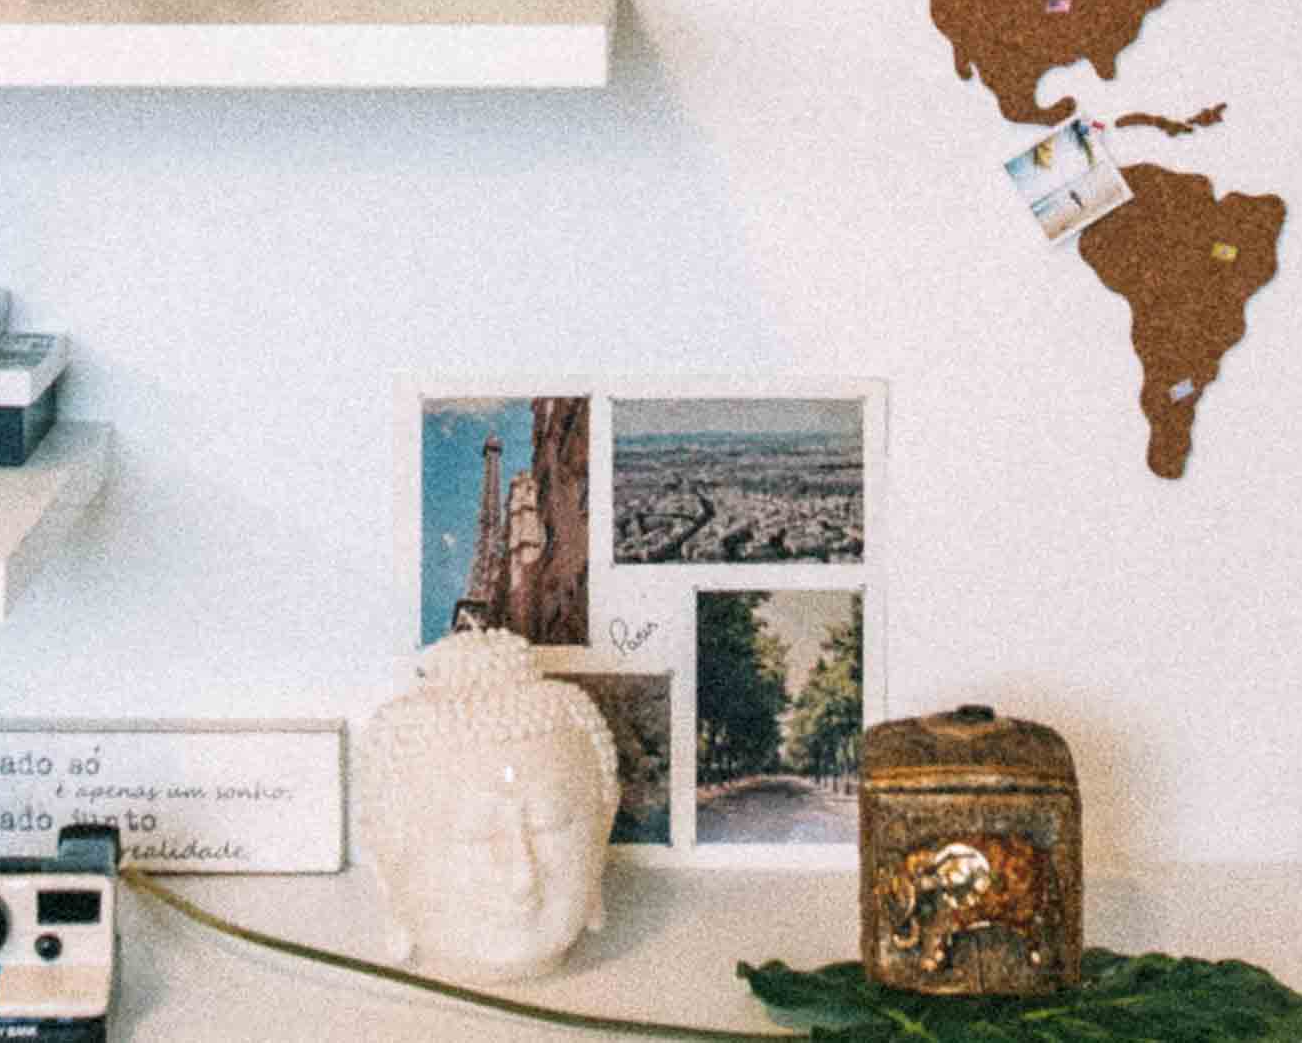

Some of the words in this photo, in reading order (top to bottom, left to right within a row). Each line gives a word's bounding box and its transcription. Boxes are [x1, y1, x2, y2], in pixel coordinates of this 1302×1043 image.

[68, 746, 101, 775] só
[74, 784, 157, 808] apenas
[167, 785, 208, 800] um
